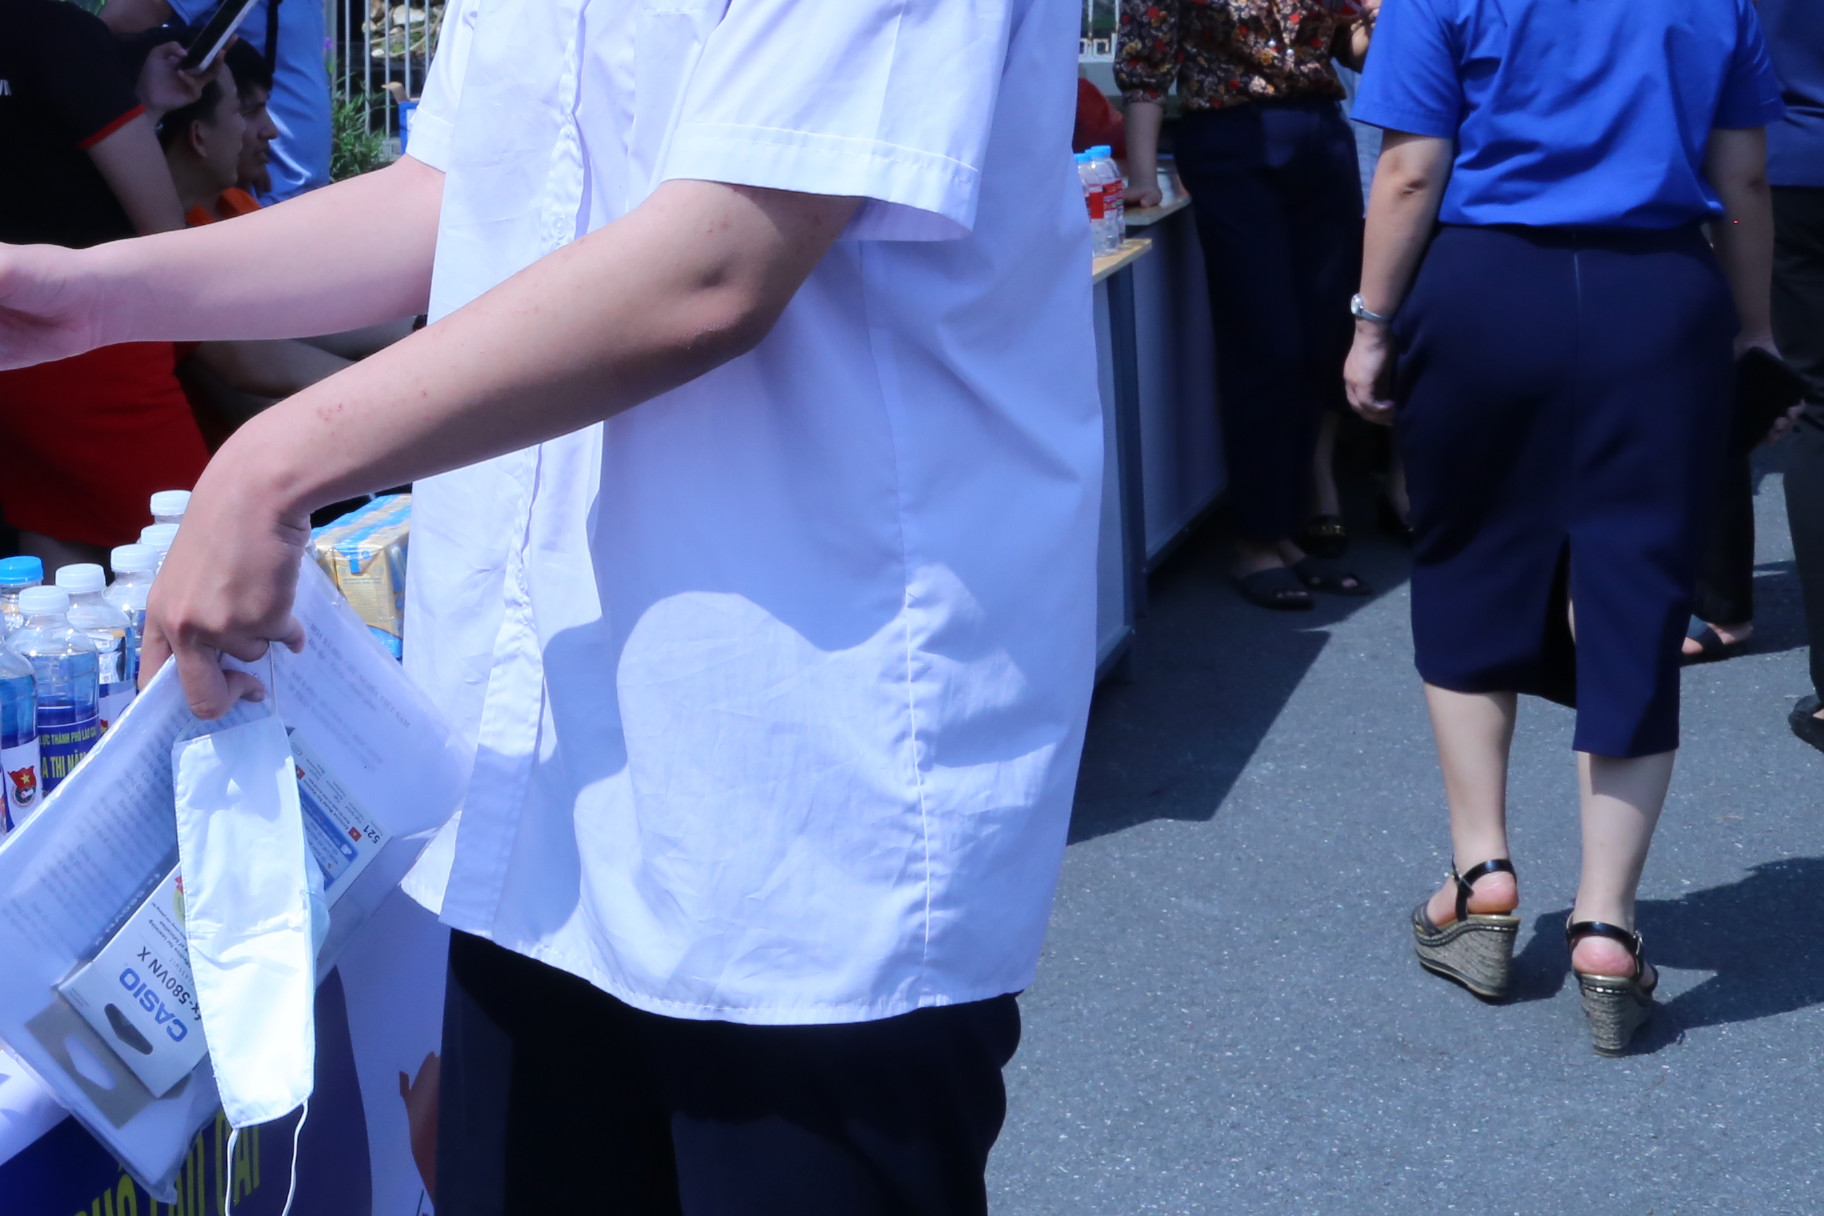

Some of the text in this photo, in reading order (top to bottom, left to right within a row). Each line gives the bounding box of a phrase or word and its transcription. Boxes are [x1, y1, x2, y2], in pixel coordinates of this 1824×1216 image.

[49, 755, 66, 778] THI
[363, 824, 381, 845] 521
[136, 946, 152, 962] X
[119, 967, 188, 1043] CASIO
